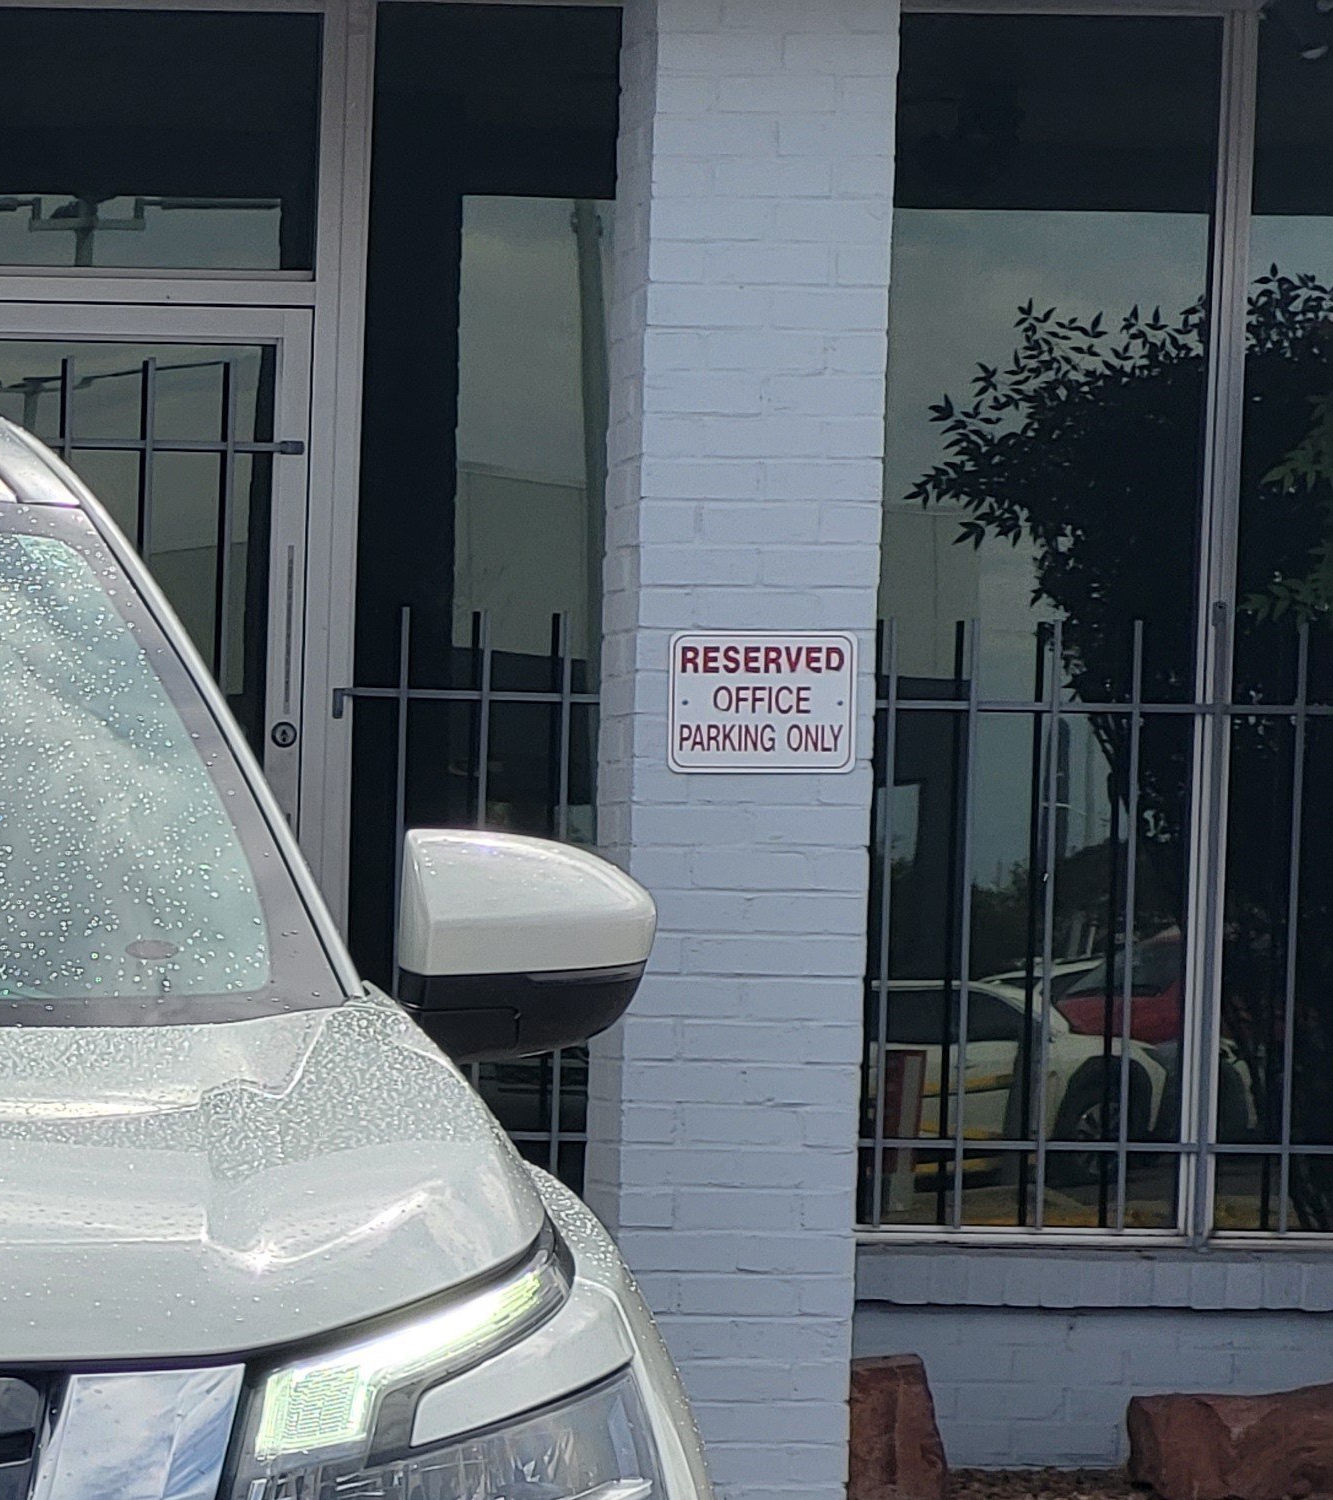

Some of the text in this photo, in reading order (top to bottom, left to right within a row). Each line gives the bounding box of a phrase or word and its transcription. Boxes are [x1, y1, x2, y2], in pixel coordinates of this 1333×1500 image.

[680, 646, 845, 674] RESERVED
[713, 685, 812, 714] OFFICE
[679, 724, 843, 752] PARKING ONLY
